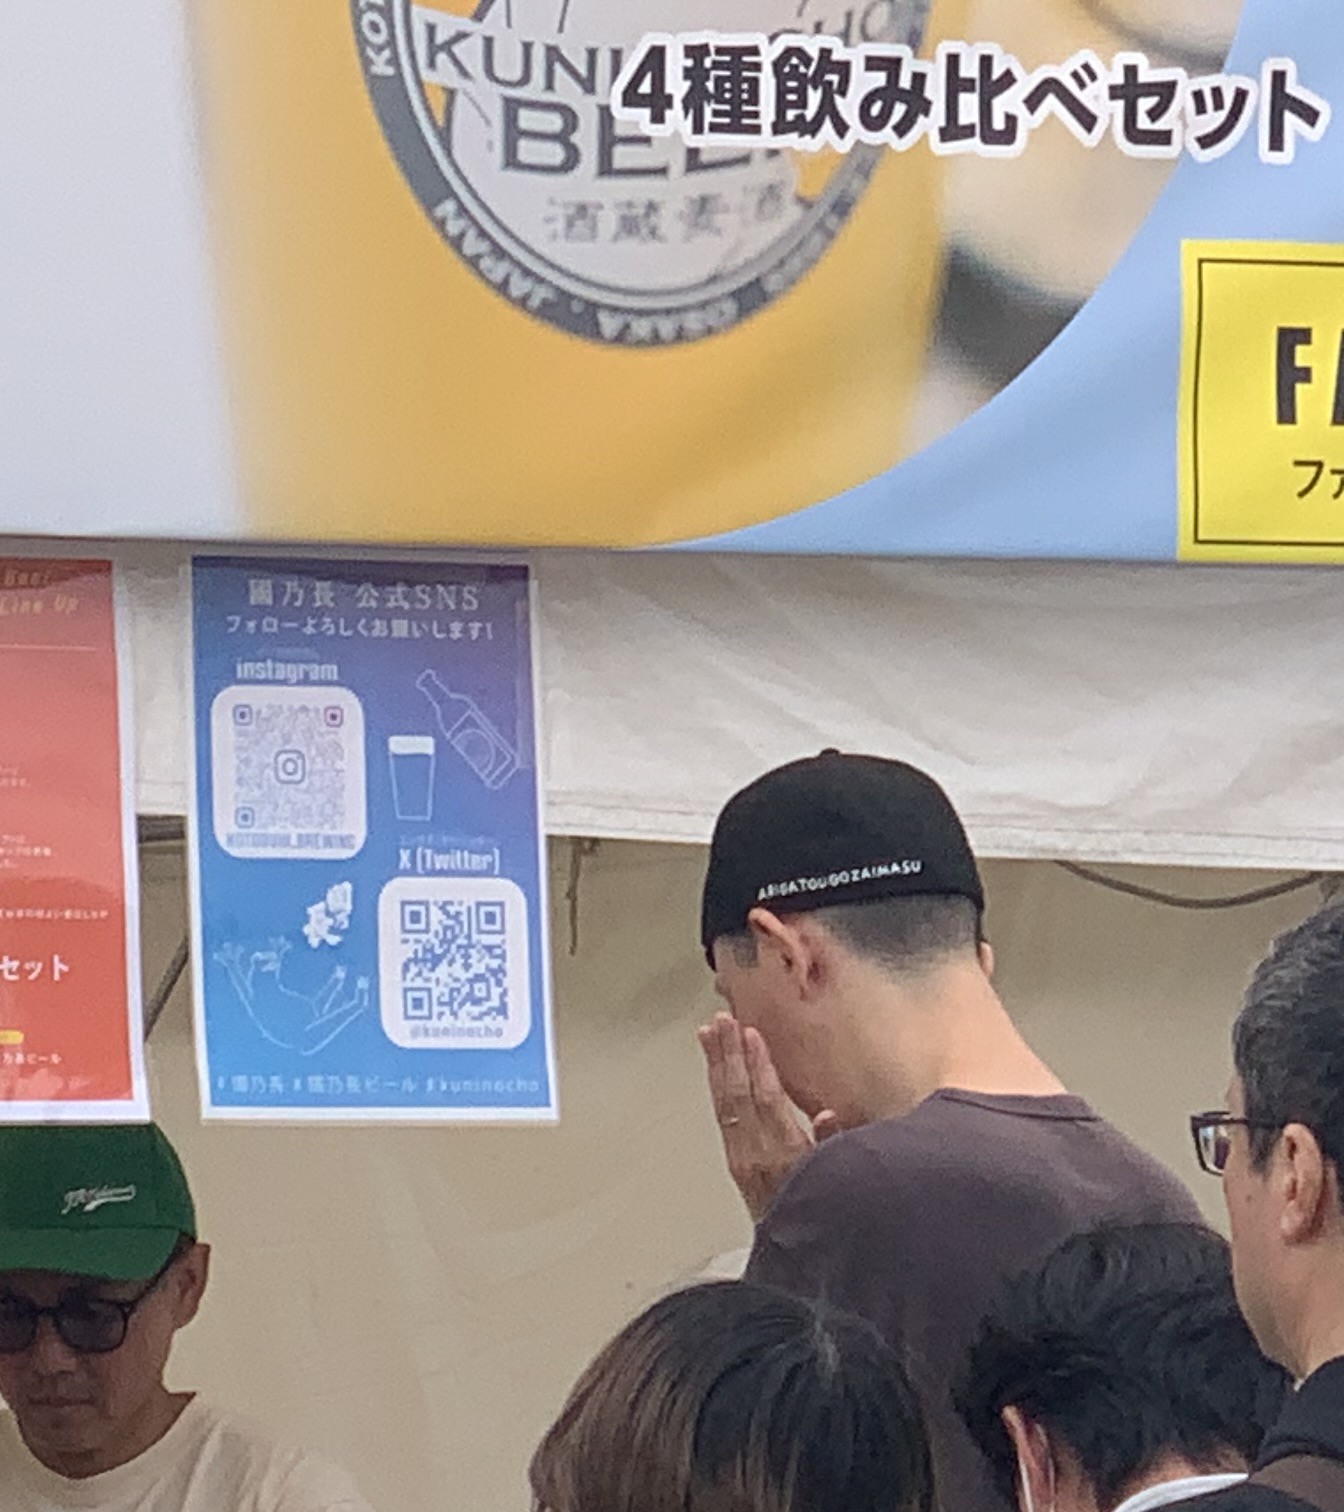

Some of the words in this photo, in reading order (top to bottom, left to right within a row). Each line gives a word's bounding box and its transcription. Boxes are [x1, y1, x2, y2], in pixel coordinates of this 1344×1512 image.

[620, 44, 1322, 153] 4種飲み比べセット
[1275, 327, 1344, 426] F
